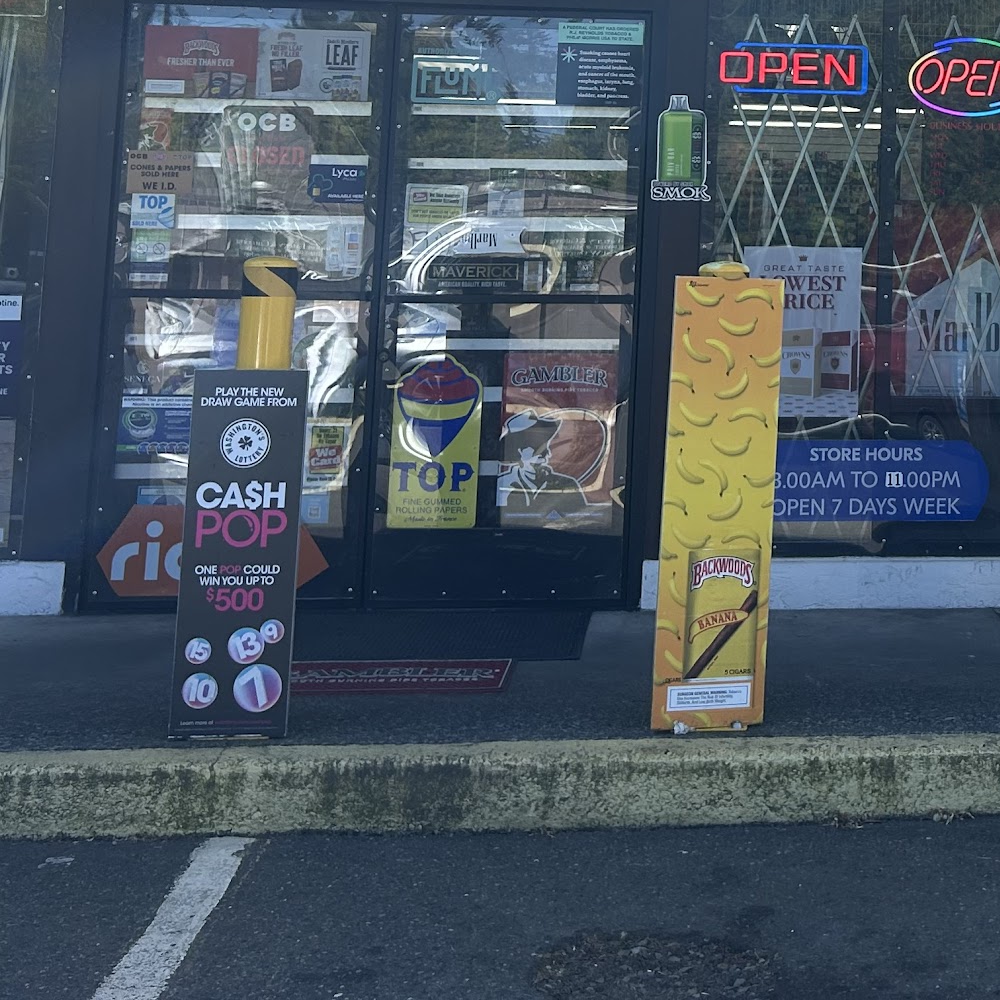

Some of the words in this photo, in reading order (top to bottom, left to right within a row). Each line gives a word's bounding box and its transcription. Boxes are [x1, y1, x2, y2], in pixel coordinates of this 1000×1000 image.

[167, 57, 198, 66] FRESHER
[199, 58, 216, 66] THAN
[218, 58, 234, 67] EVER
[326, 44, 359, 66] LEAF
[720, 51, 856, 87] OPEN
[238, 112, 297, 132] OCB
[929, 121, 972, 130] BUSINESS
[332, 167, 358, 178] Lyca
[142, 182, 158, 190] WE
[161, 182, 176, 190] I.D.
[653, 187, 710, 200] SMOK
[139, 196, 168, 209] TOP
[432, 266, 513, 278] MAVERICK
[764, 264, 801, 272] GREAT
[760, 275, 846, 292] WEST
[784, 294, 834, 310] RICE
[510, 365, 608, 388] GAMBLER
[215, 387, 240, 396] PLAY
[240, 388, 258, 396] THE
[260, 388, 284, 396] NEW
[200, 397, 232, 406] DRAW
[234, 398, 265, 406] GAME
[267, 398, 297, 406] FROM
[224, 423, 266, 455] WASHINGTON'S
[234, 446, 265, 464] LOTTERY
[310, 456, 342, 467] Card
[315, 448, 337, 458] We
[810, 448, 860, 462] STORE
[866, 448, 922, 462] HOURS
[392, 461, 474, 492] TOP
[851, 471, 878, 488] TO
[886, 471, 960, 488] 11.00PM
[195, 480, 286, 510] CA$H
[402, 498, 422, 506] FINE
[424, 498, 462, 506] GUMMED
[396, 506, 432, 514] ROLLING
[434, 506, 468, 514] PAPERS
[774, 498, 825, 516] OPEN
[832, 498, 842, 516] 7
[850, 498, 896, 515] DAYS
[902, 498, 960, 514] WEEK
[195, 509, 288, 548] POP
[195, 565, 218, 574] ONE
[220, 565, 242, 574] POP
[244, 564, 280, 574] COULD
[691, 556, 754, 590] BACKWOODS
[200, 576, 220, 586] WIN
[222, 576, 244, 586] YOU
[246, 576, 260, 585] UP
[260, 576, 274, 585] TO
[206, 587, 264, 612] $500
[697, 611, 738, 630] BANANA
[264, 623, 278, 640] 9
[190, 641, 210, 661] 15
[235, 632, 262, 660] 13
[187, 678, 216, 704] 10
[240, 665, 268, 708] 7
